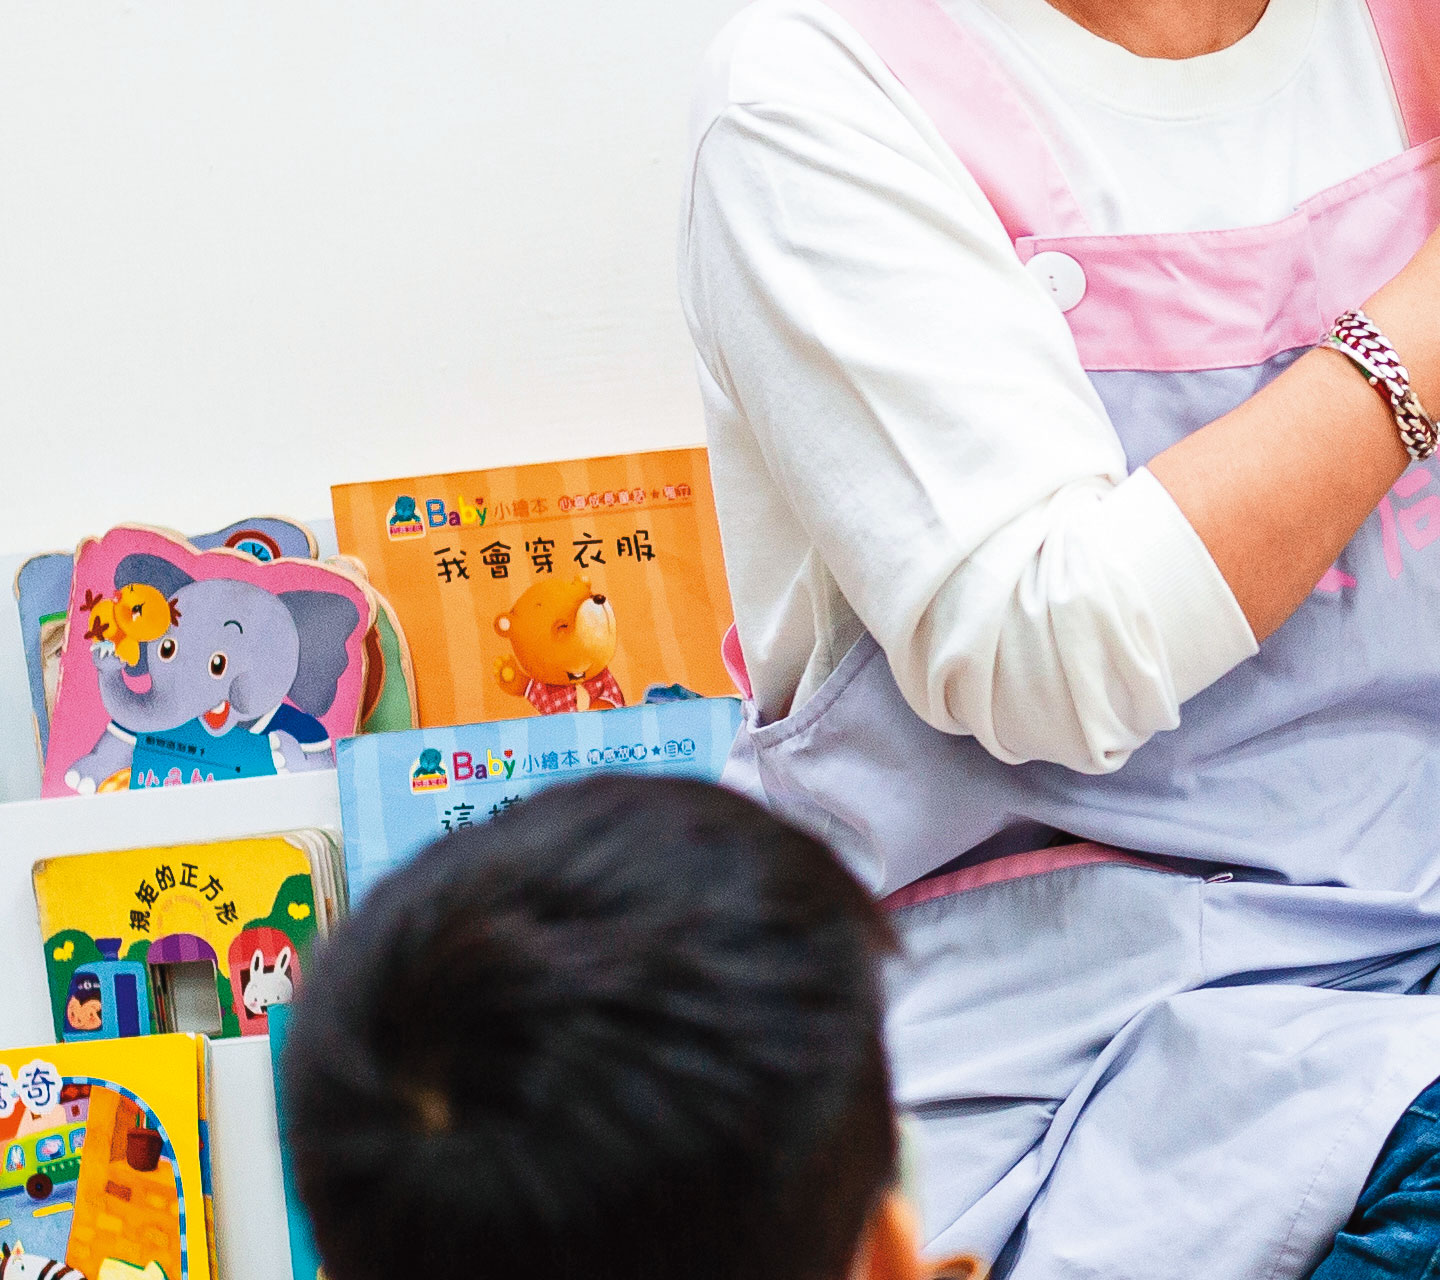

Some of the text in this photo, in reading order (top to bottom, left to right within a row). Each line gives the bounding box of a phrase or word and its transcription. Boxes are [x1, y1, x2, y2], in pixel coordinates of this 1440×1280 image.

[426, 495, 488, 528] Baby
[493, 498, 550, 519] 小繪本
[433, 530, 657, 583] 我會穿衣服
[452, 748, 516, 781] Baby
[522, 749, 581, 773] 小繪本
[129, 862, 239, 934] 規矩的正方形
